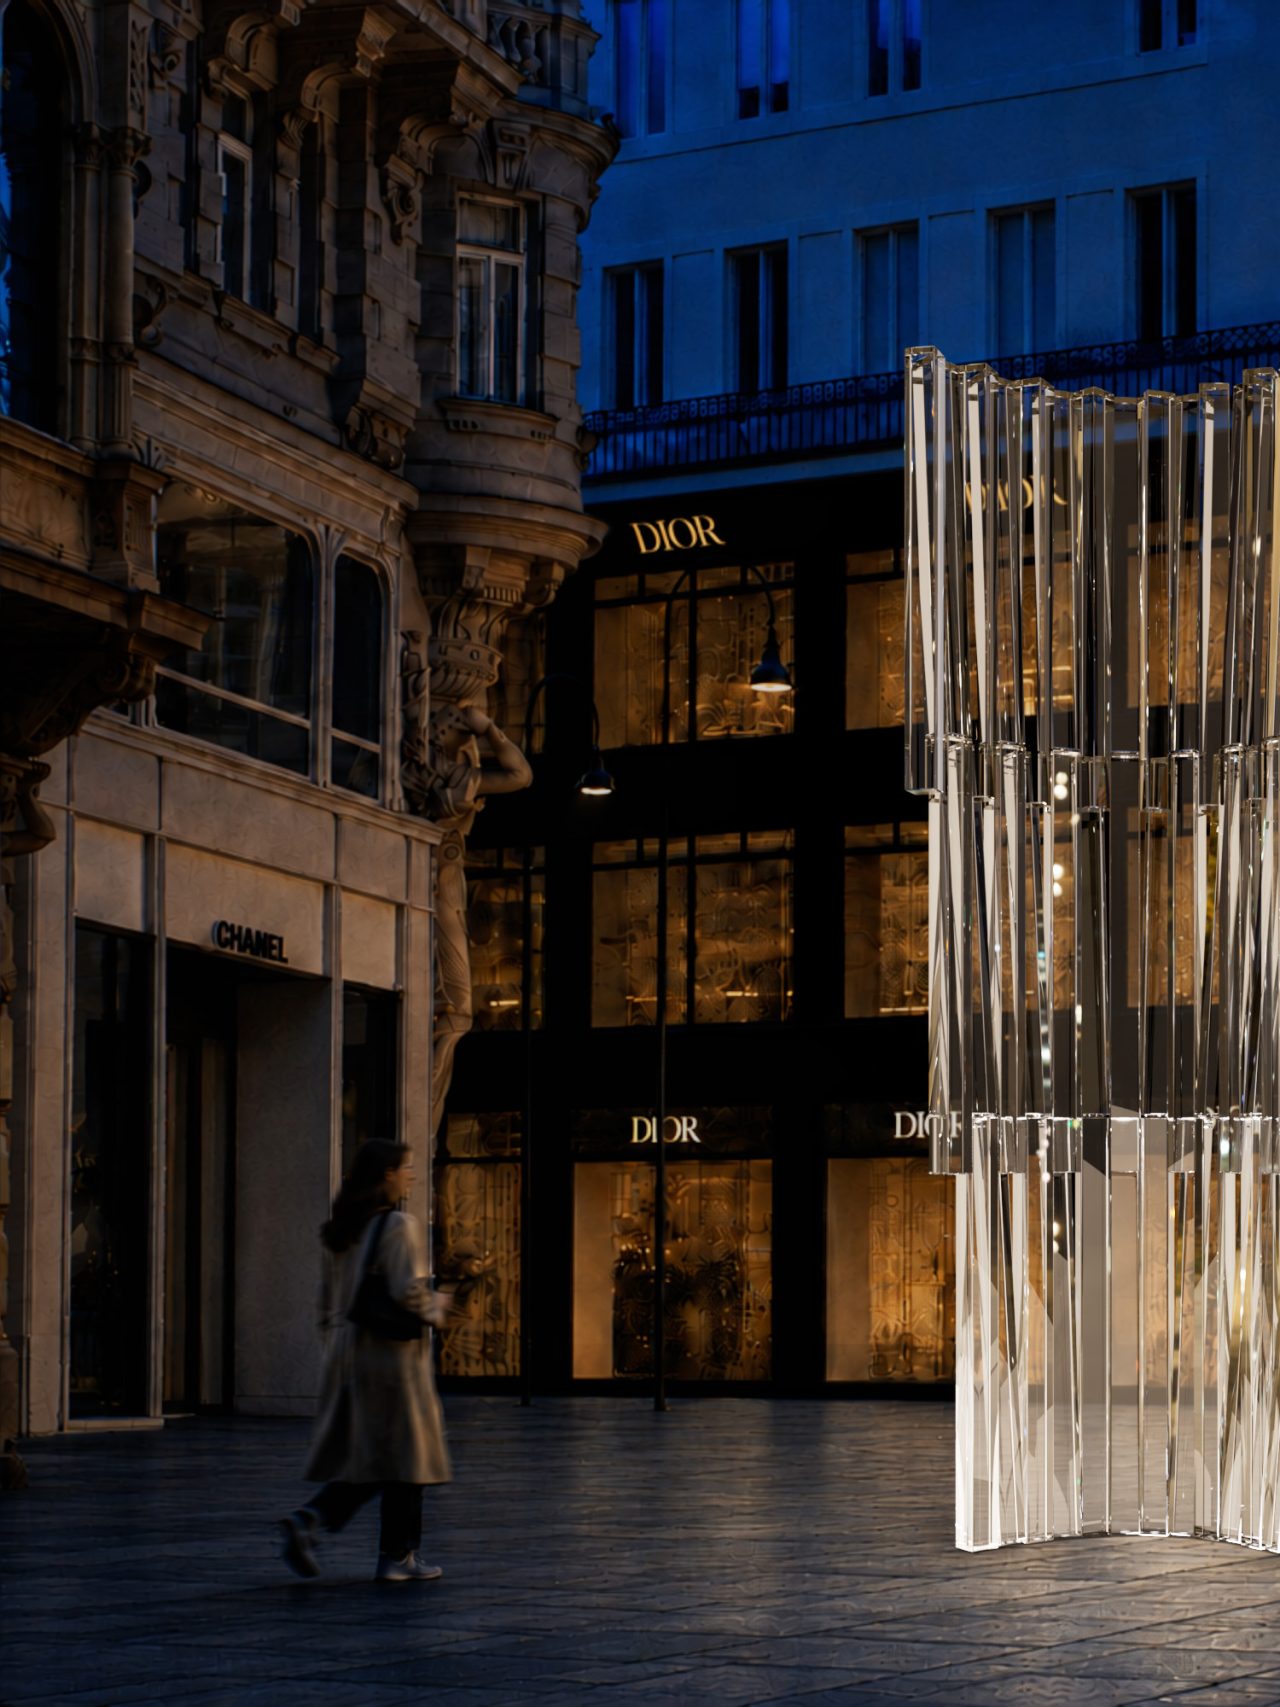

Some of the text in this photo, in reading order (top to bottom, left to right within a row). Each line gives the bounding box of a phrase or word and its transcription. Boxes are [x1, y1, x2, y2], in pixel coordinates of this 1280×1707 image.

[628, 514, 727, 554] DIOR
[213, 920, 288, 963] CHANEL
[630, 1115, 702, 1144] DIOR
